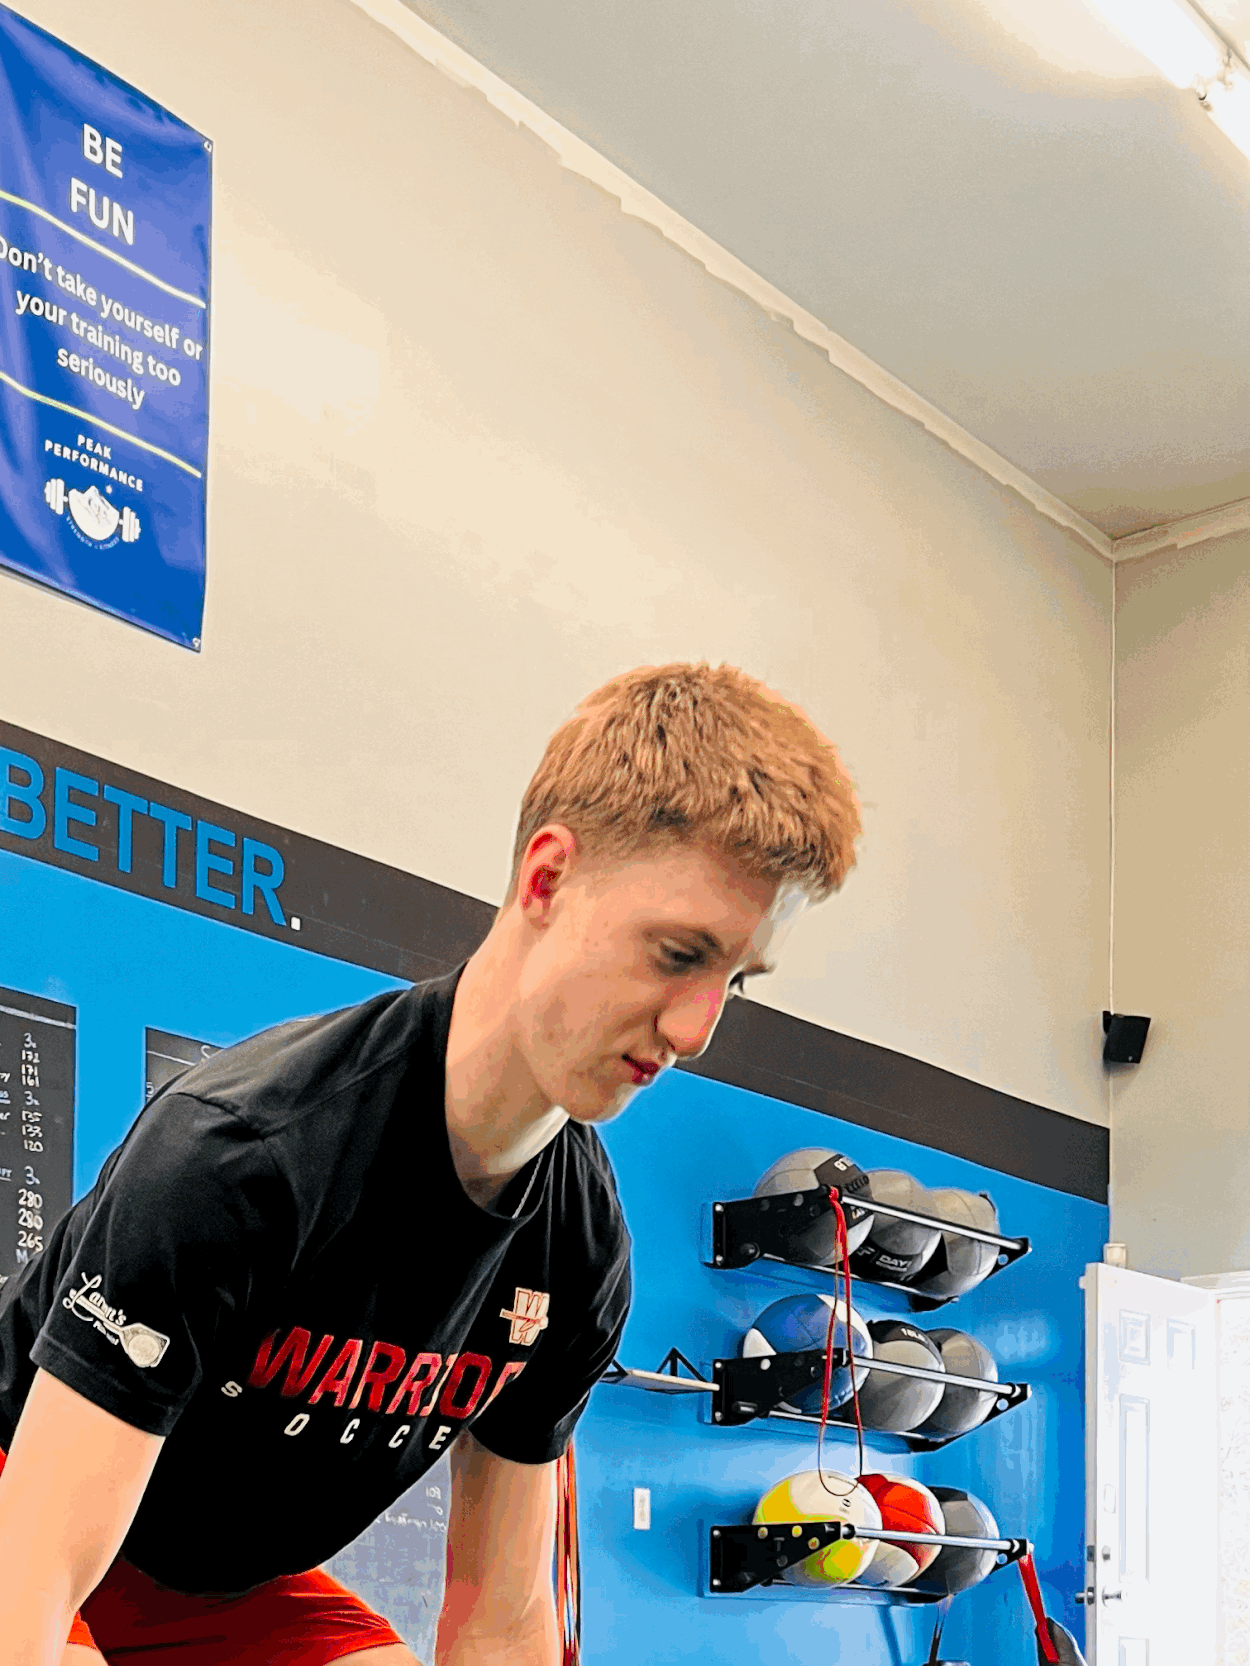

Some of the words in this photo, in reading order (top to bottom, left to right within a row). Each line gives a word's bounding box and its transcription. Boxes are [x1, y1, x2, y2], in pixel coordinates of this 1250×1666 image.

[83, 123, 123, 179] BE
[70, 177, 134, 246] FUN
[15, 290, 67, 326] your
[71, 312, 145, 375] training
[147, 355, 181, 387] too
[56, 265, 97, 306] take
[100, 294, 180, 349] yourself
[183, 338, 203, 361] or
[57, 348, 145, 411] seriously
[44, 439, 143, 492] PERFORMANCE
[77, 434, 112, 460] PEAK
[18, 1188, 43, 1209] 280
[18, 1208, 44, 1231] 280
[18, 1230, 44, 1252] 265
